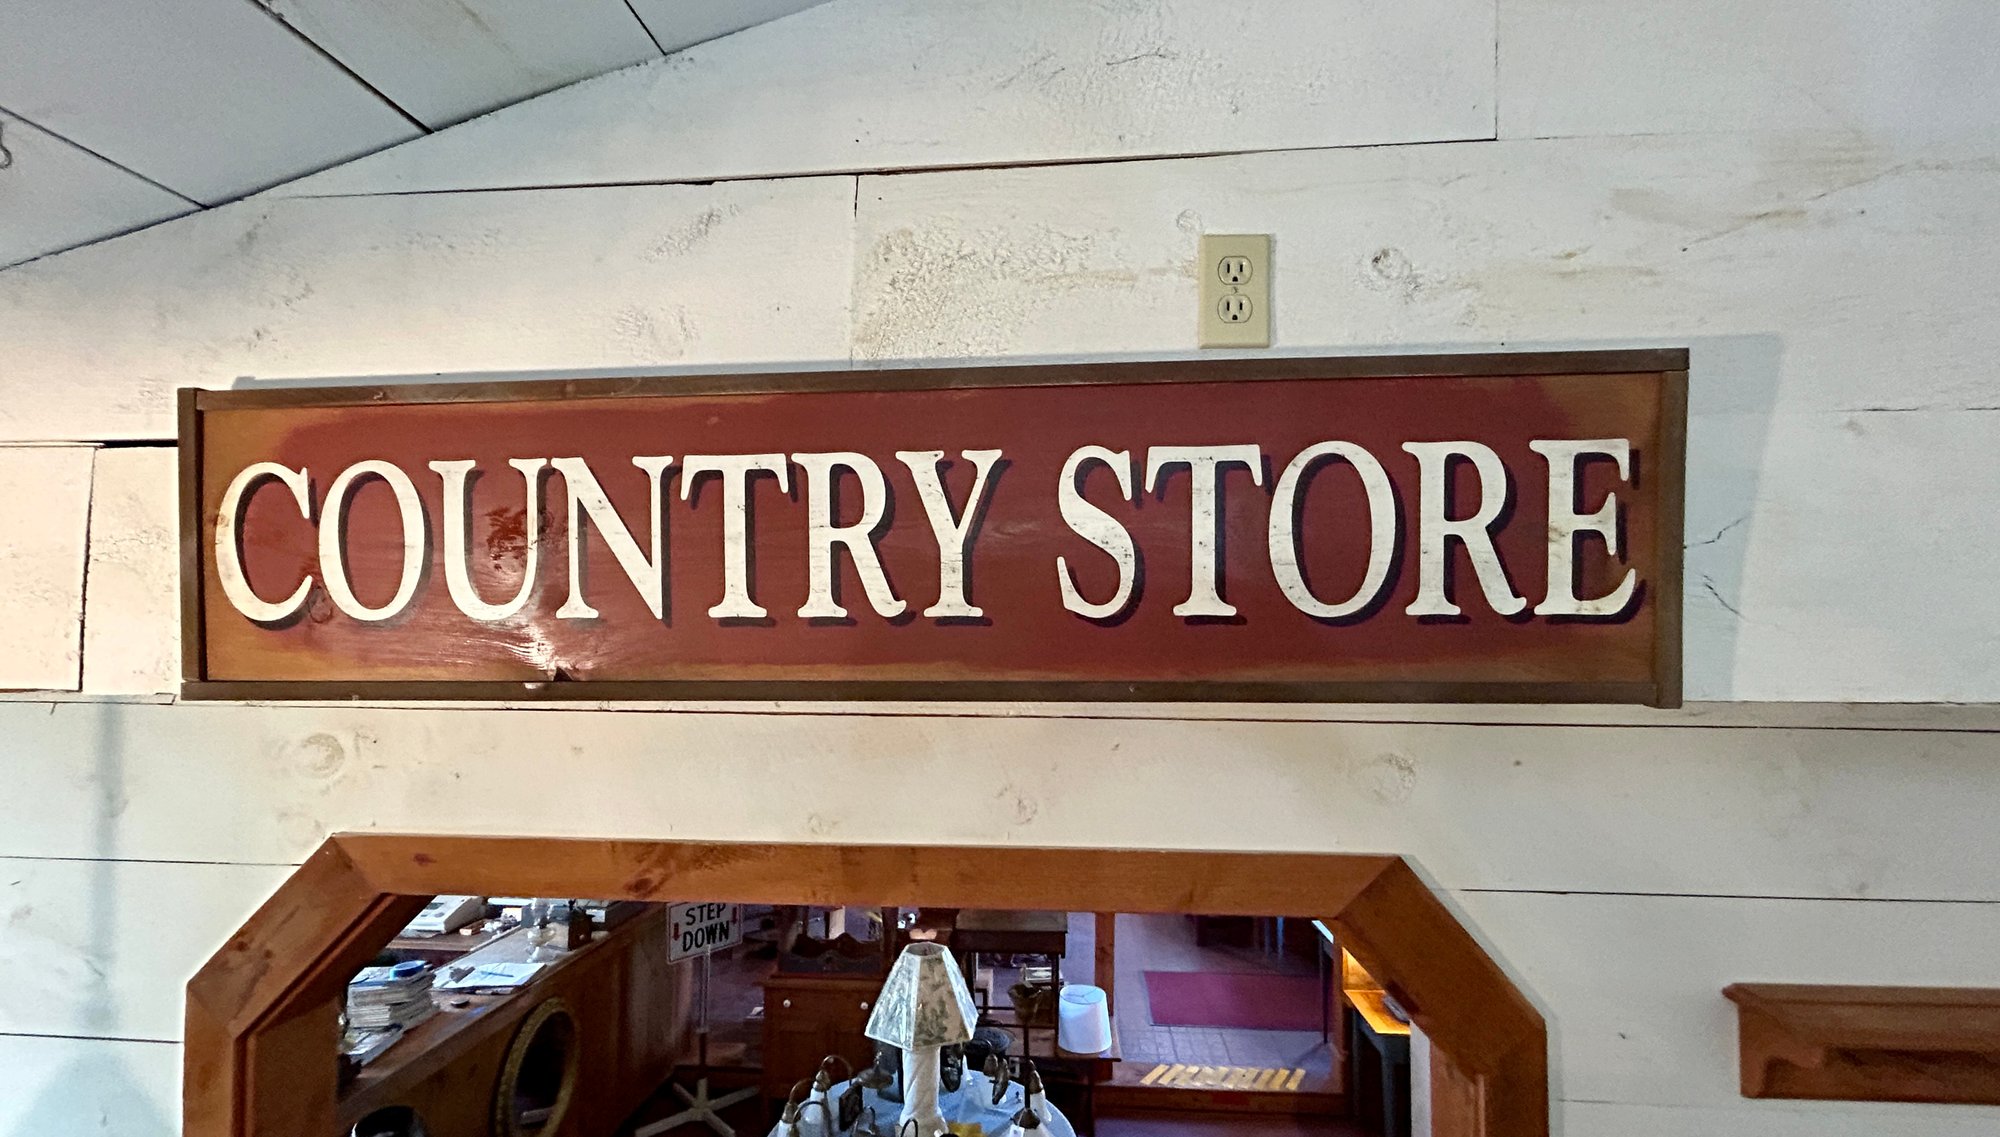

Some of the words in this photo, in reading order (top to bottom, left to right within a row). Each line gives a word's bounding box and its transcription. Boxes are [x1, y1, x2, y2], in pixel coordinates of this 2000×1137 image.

[215, 449, 1003, 622] COUNTRY
[1056, 439, 1637, 618] STORE
[685, 903, 726, 925] STEP
[682, 921, 730, 952] DOWN
